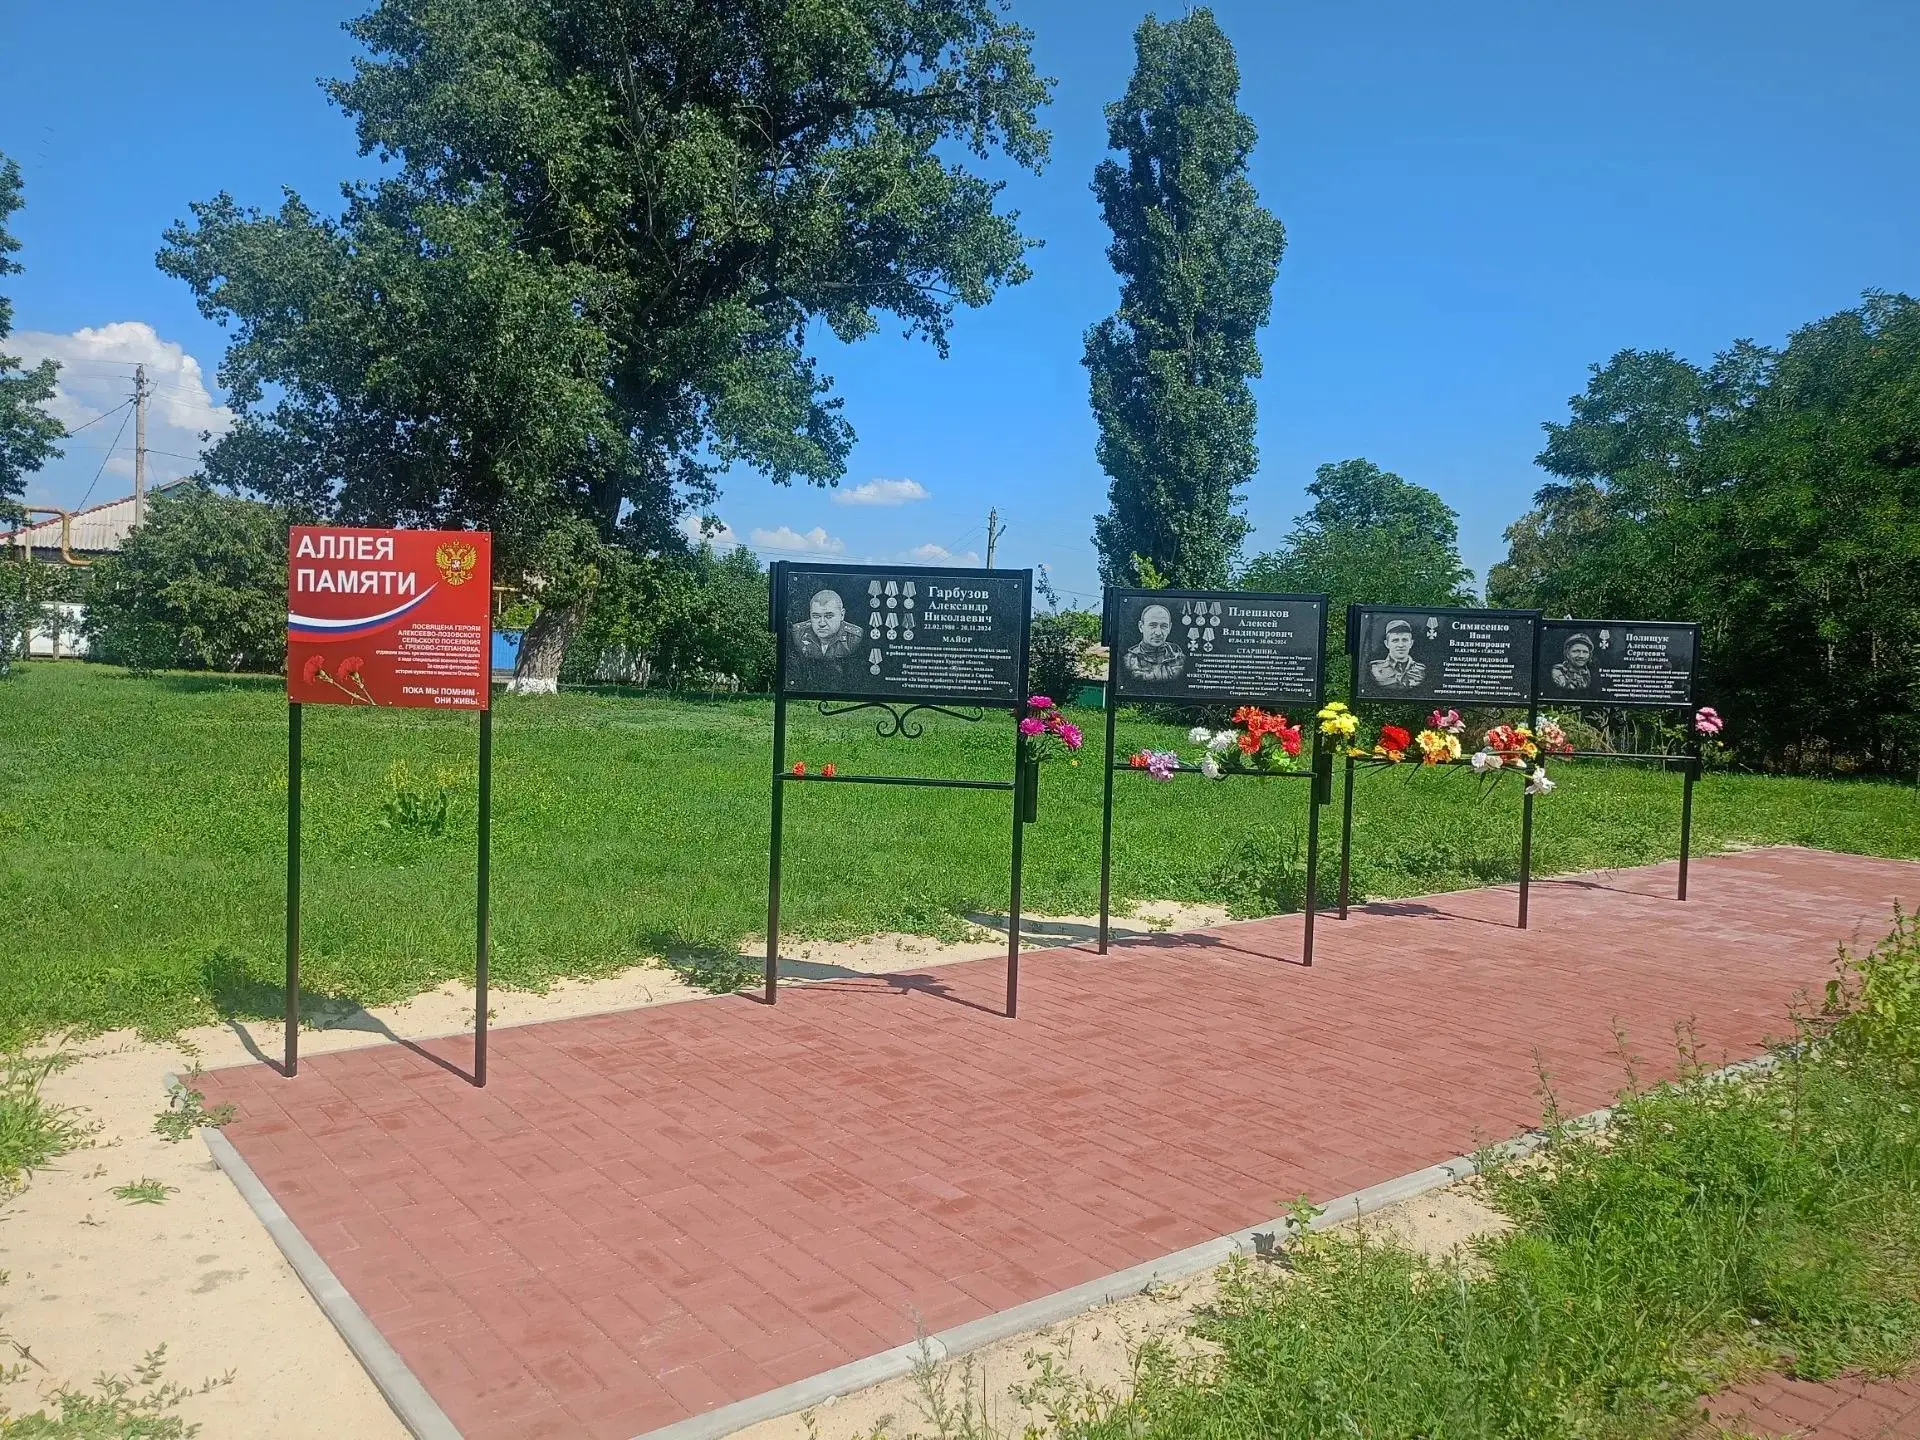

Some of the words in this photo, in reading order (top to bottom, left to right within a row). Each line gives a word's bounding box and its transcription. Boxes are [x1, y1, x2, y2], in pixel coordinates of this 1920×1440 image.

[296, 535, 394, 560] АЛЛЕЯ
[297, 568, 416, 595] ПАМЯТИ
[928, 586, 989, 601] Гарбузов
[928, 601, 988, 613] Александр
[1228, 607, 1289, 618] Плешаков
[924, 612, 992, 623] Николаевич
[1238, 619, 1278, 628] Алексей
[1452, 621, 1509, 631] Симисенко
[1222, 628, 1293, 639] Владимирович
[1626, 634, 1669, 644] Полищук
[1449, 640, 1510, 649] Владимирович
[1627, 643, 1667, 651] Александр
[441, 688, 475, 696] ПОМНИМ
